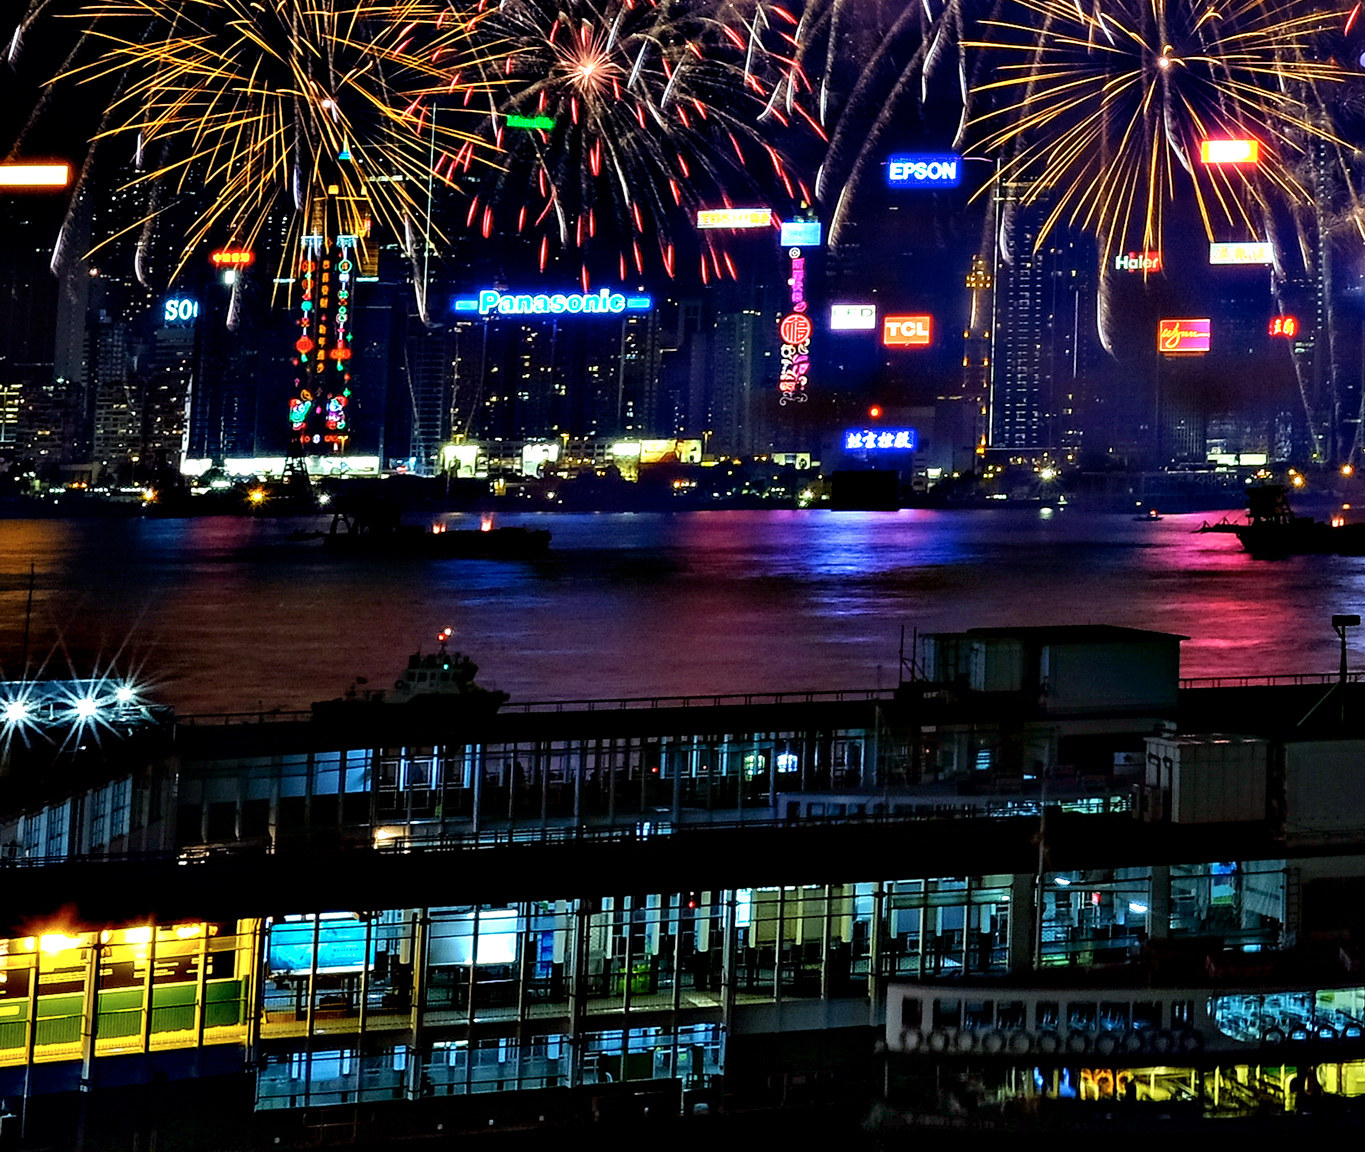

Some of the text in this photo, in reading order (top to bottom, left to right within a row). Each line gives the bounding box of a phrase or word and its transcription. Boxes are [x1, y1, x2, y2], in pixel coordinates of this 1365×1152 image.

[889, 161, 957, 180] EPSON
[1115, 254, 1159, 270] Haier
[478, 288, 626, 315] Panasonic
[886, 321, 929, 337] TCL
